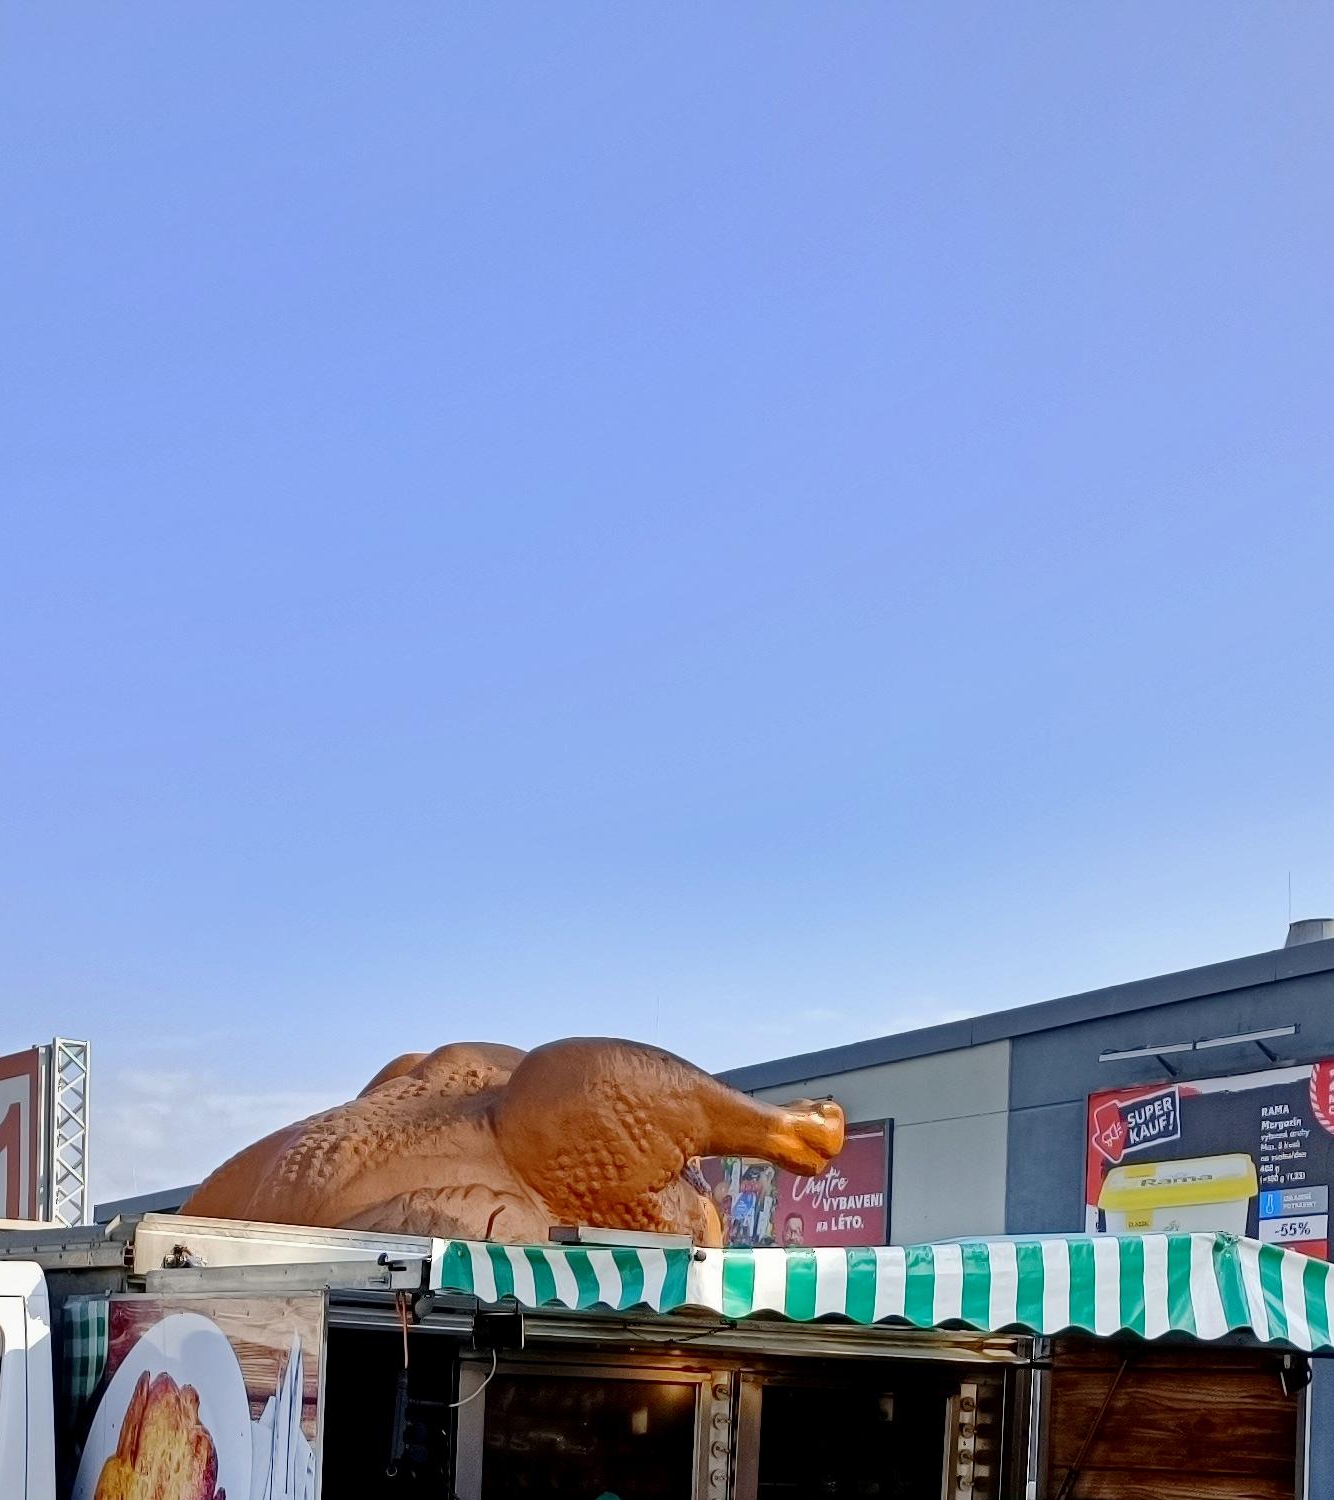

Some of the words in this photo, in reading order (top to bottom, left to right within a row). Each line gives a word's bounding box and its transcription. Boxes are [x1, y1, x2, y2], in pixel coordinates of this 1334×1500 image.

[1127, 1096, 1173, 1128] SUPER
[1261, 1104, 1290, 1117] RAMA
[1129, 1110, 1175, 1145] KAUF!
[1140, 1173, 1213, 1187] Rama
[831, 1213, 865, 1231] LÉTO.
[1275, 1220, 1311, 1237] -55%
